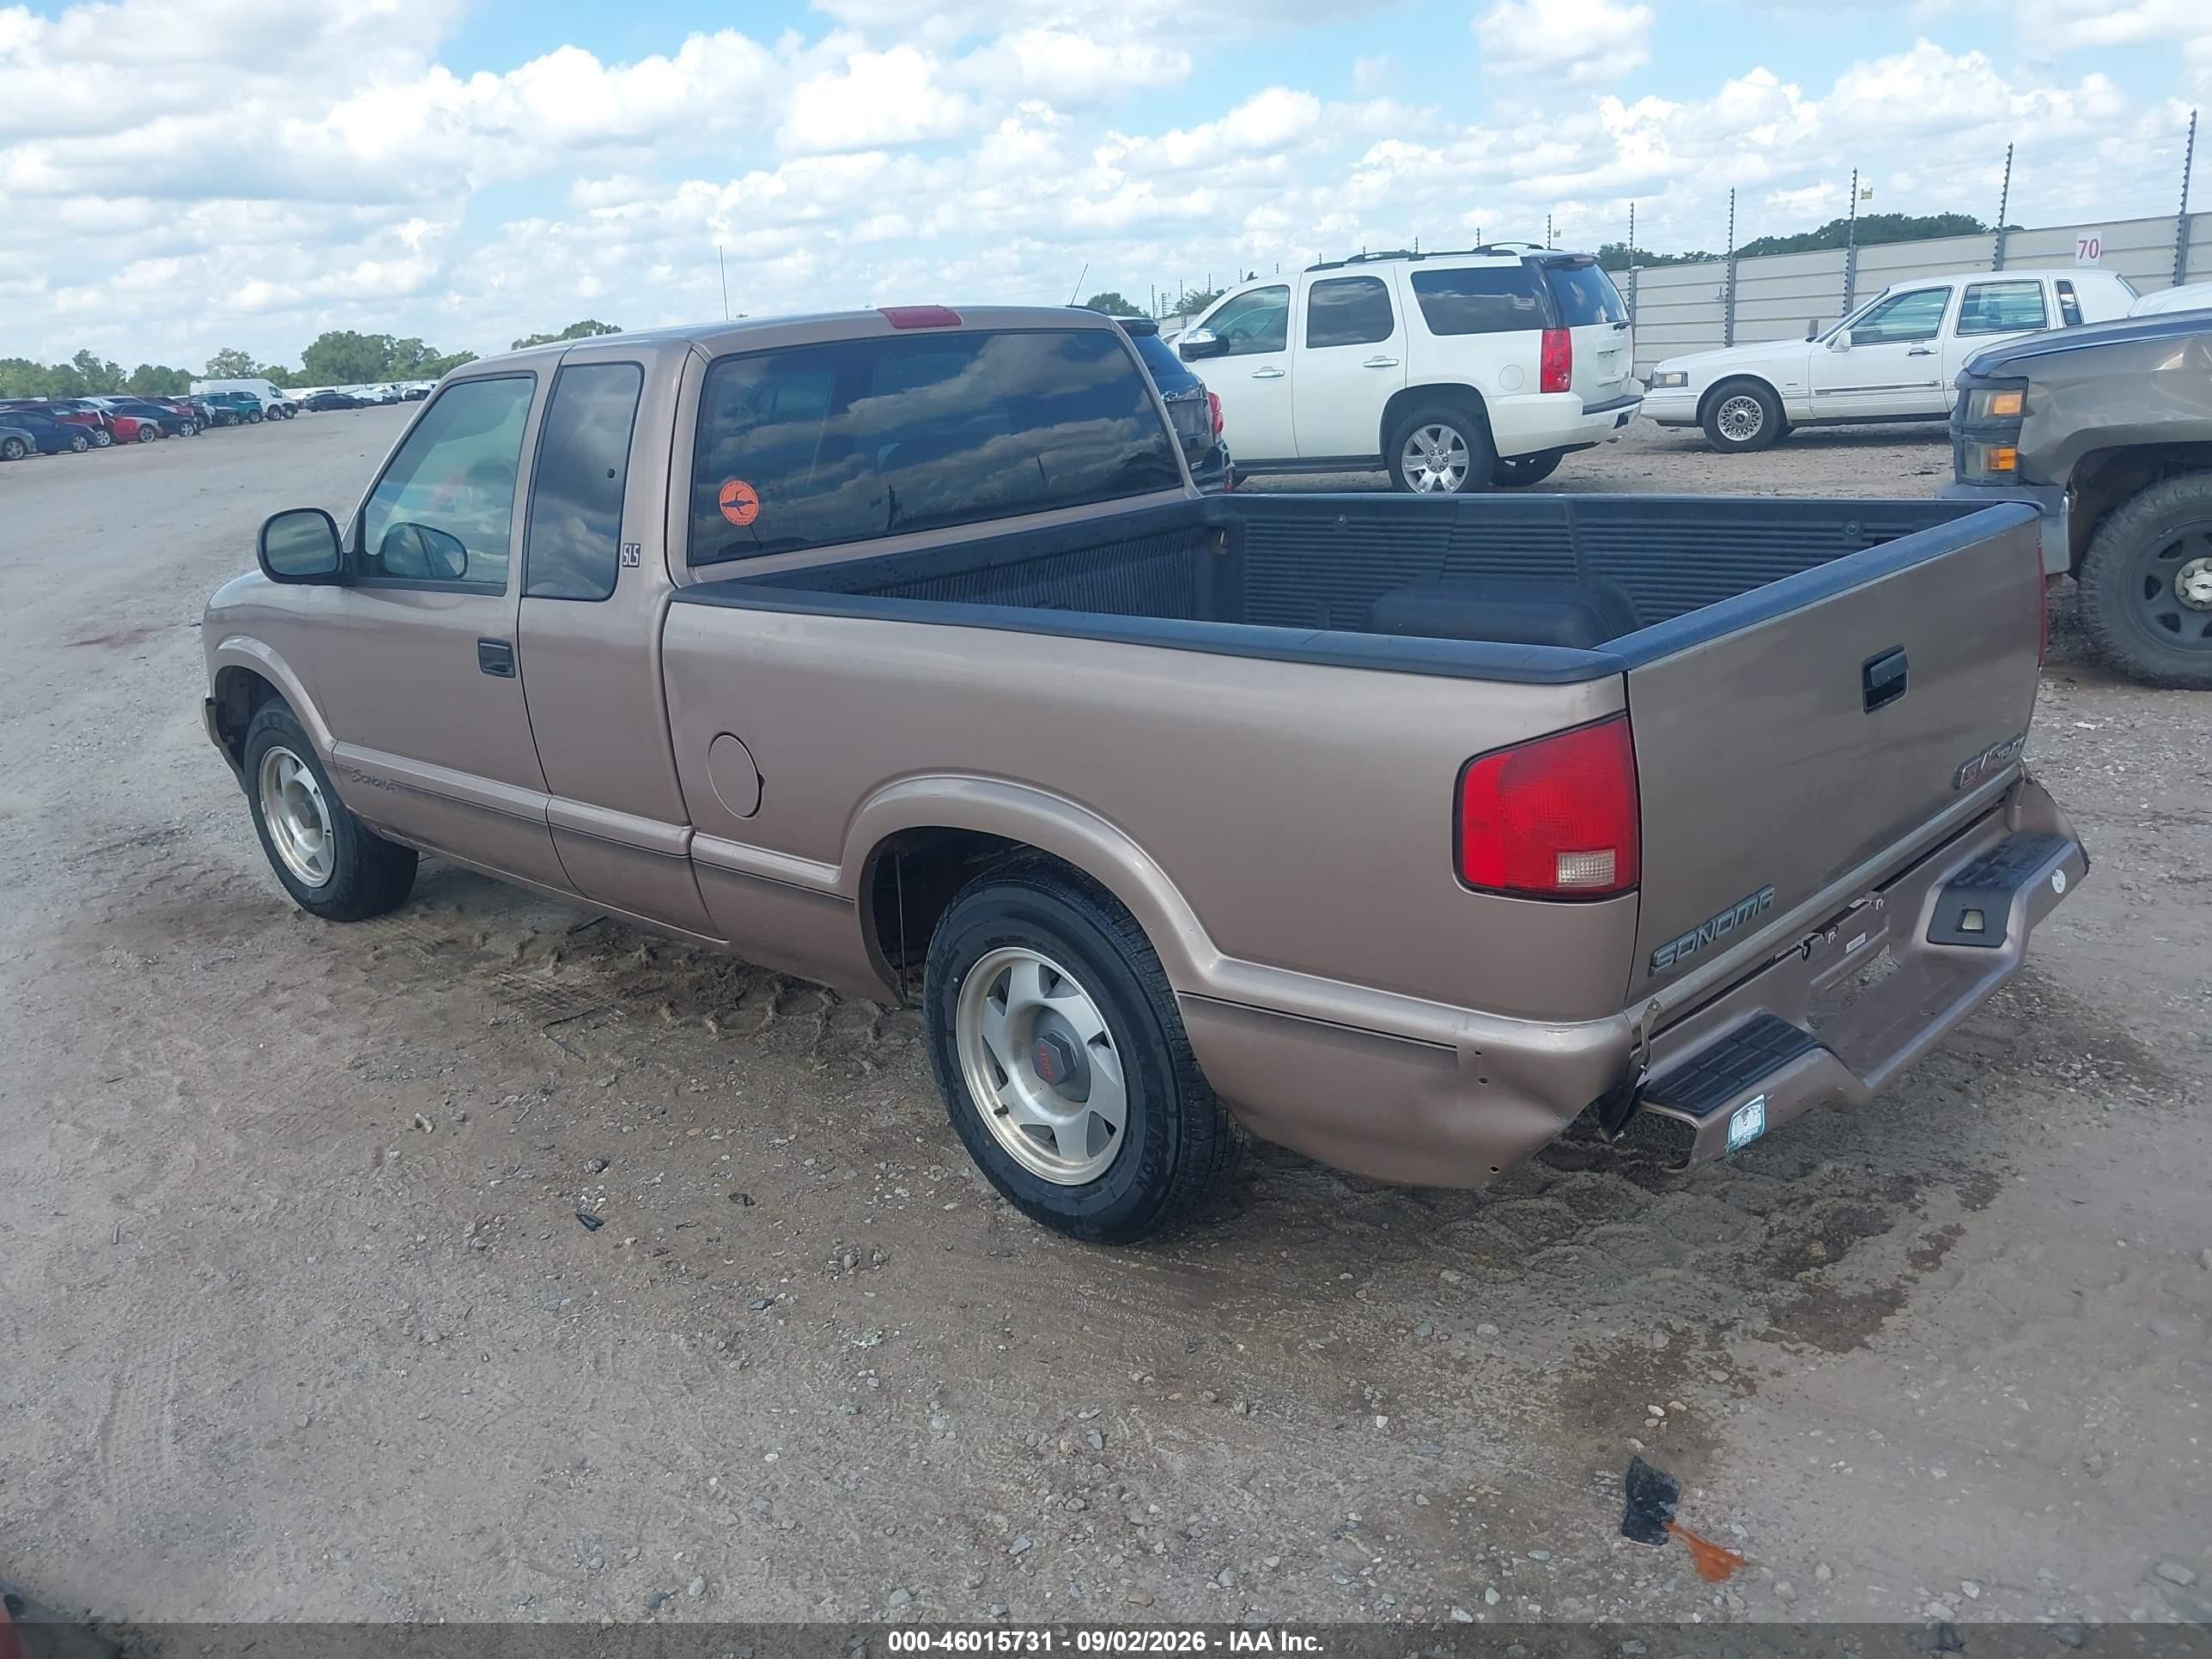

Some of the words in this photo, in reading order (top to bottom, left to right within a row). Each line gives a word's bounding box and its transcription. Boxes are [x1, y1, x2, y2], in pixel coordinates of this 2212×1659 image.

[2078, 239, 2100, 259] 70
[623, 543, 641, 567] SLS
[1650, 884, 1775, 975] SONOMA
